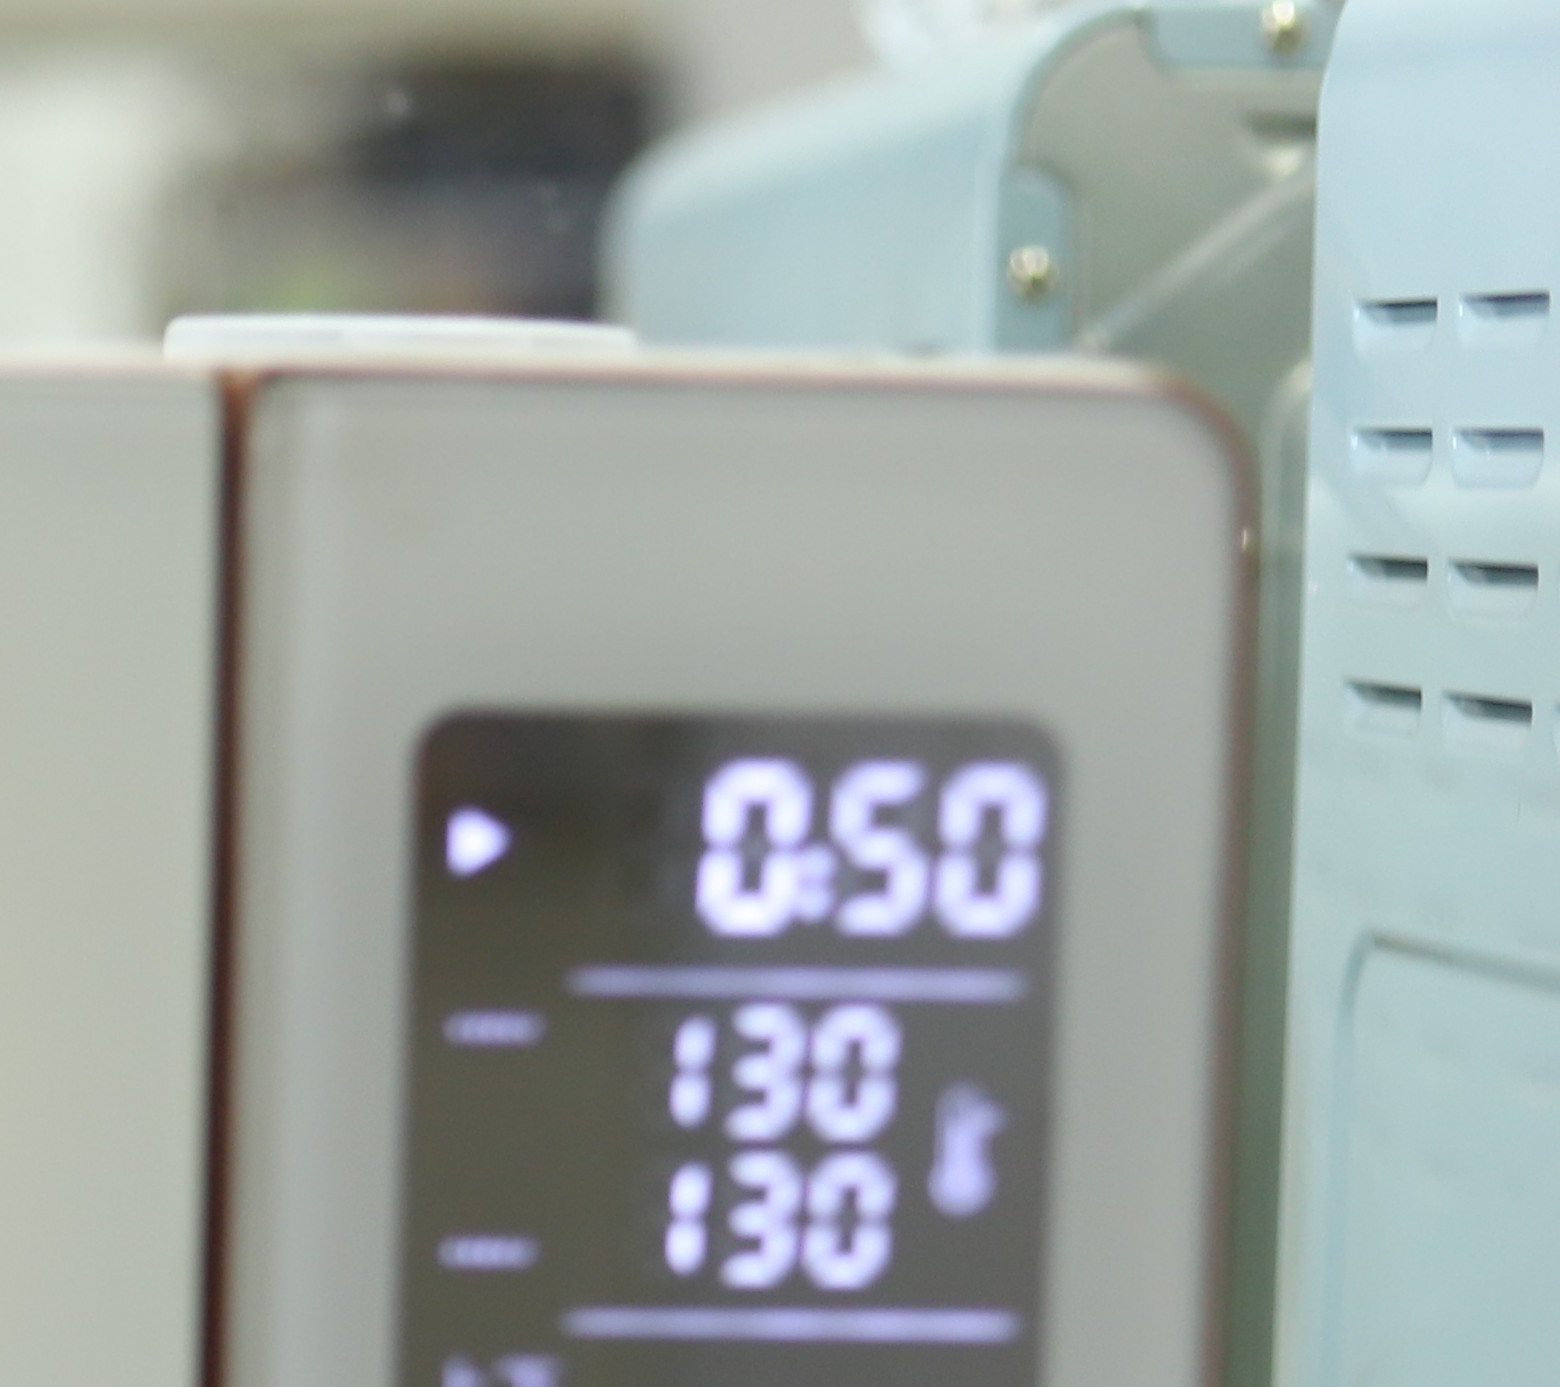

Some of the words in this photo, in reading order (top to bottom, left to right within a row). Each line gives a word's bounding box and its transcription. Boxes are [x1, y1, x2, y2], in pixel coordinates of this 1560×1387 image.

[695, 758, 1048, 940] 0:50
[668, 1002, 902, 1143] 130
[665, 1150, 896, 1290] 130
